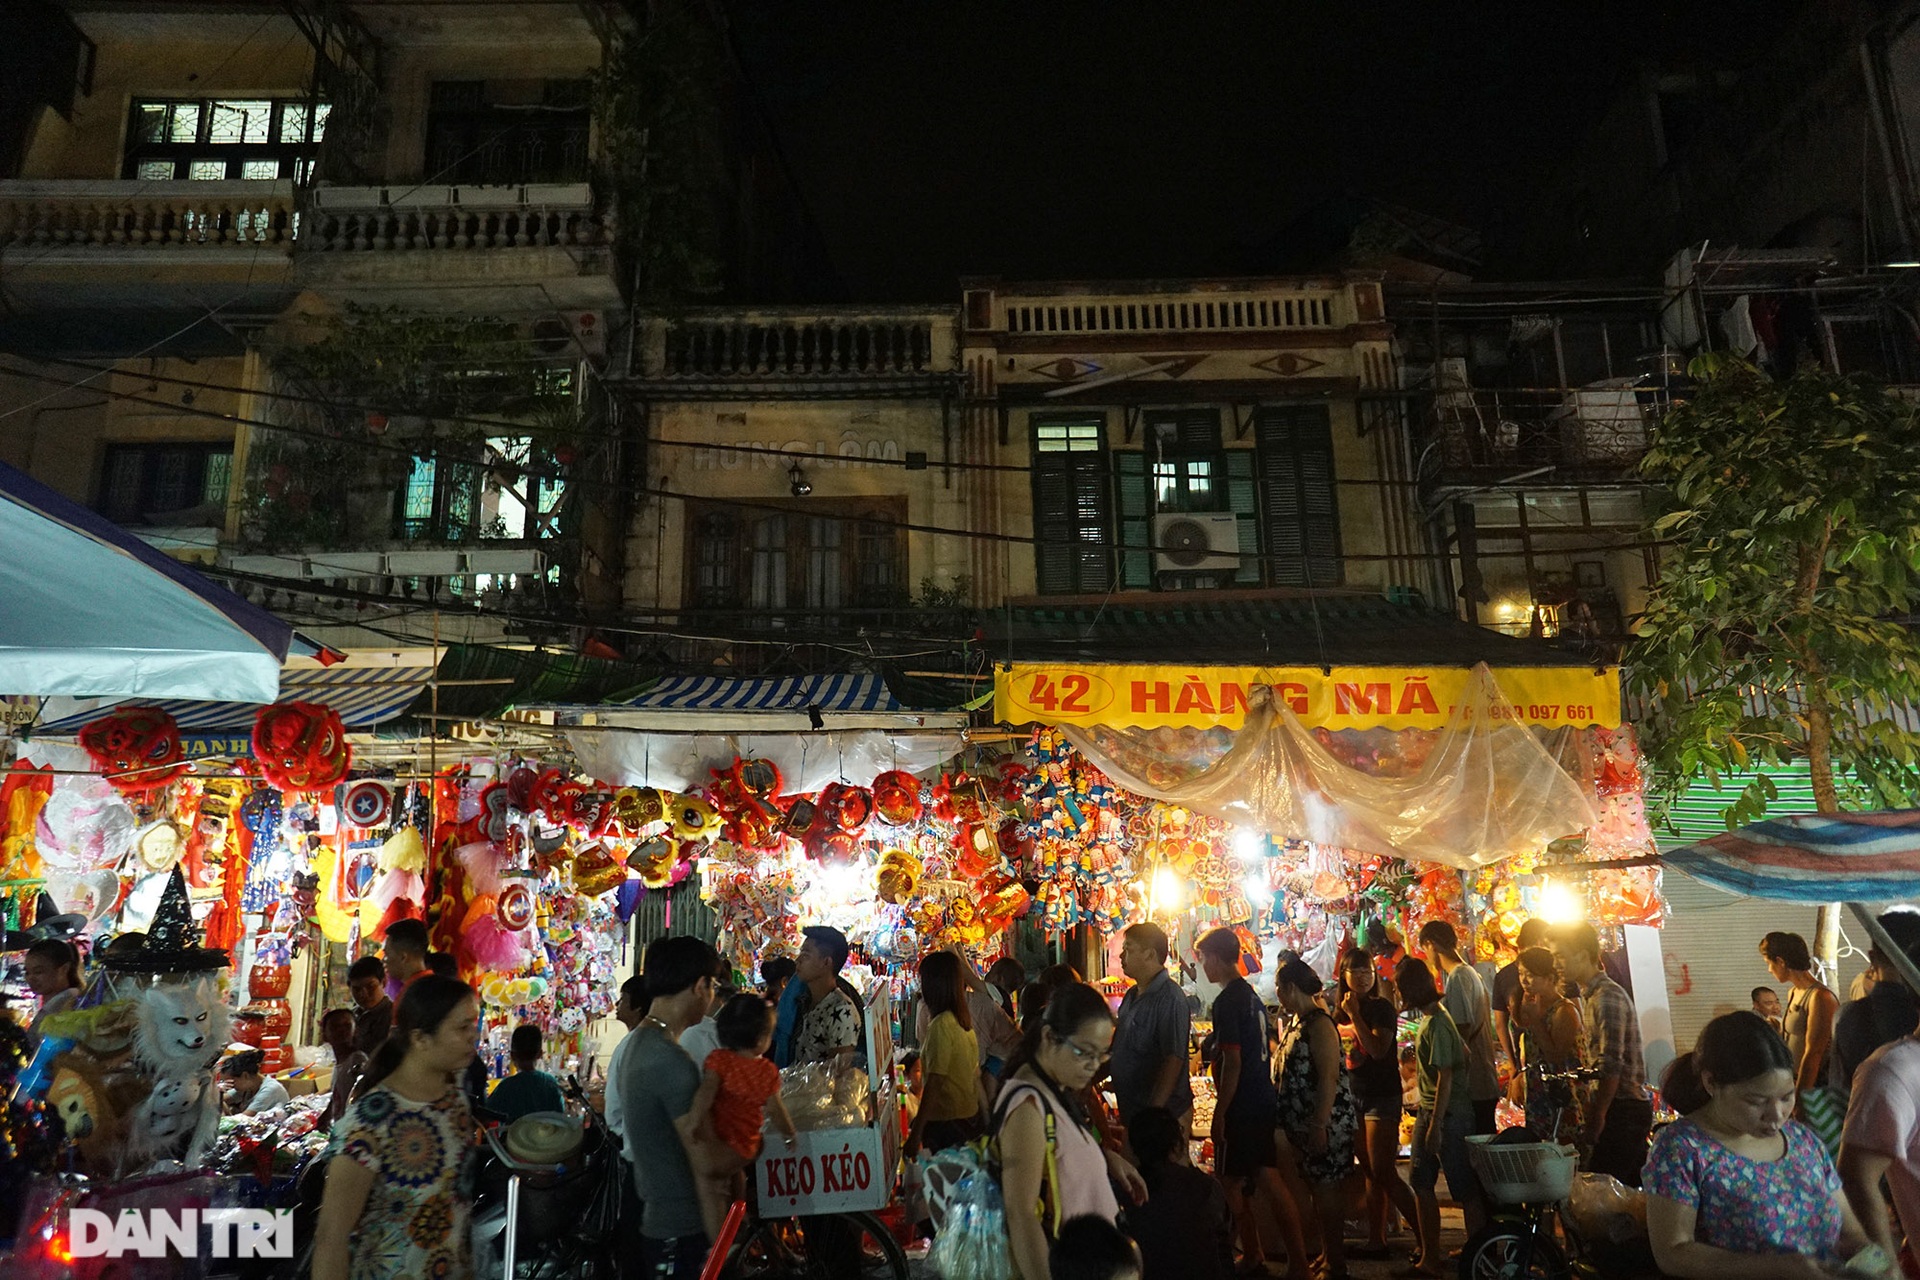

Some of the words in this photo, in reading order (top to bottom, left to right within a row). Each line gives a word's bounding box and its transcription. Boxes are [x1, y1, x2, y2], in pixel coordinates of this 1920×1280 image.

[816, 429, 900, 469] LÂM
[1028, 674, 1090, 713] 42
[1130, 675, 1309, 715] HÀNG
[1335, 675, 1440, 715] MÃ
[1529, 704, 1560, 720] 097
[1566, 704, 1594, 720] 661
[765, 1155, 816, 1206] KẸO
[820, 1142, 871, 1194] KÉO
